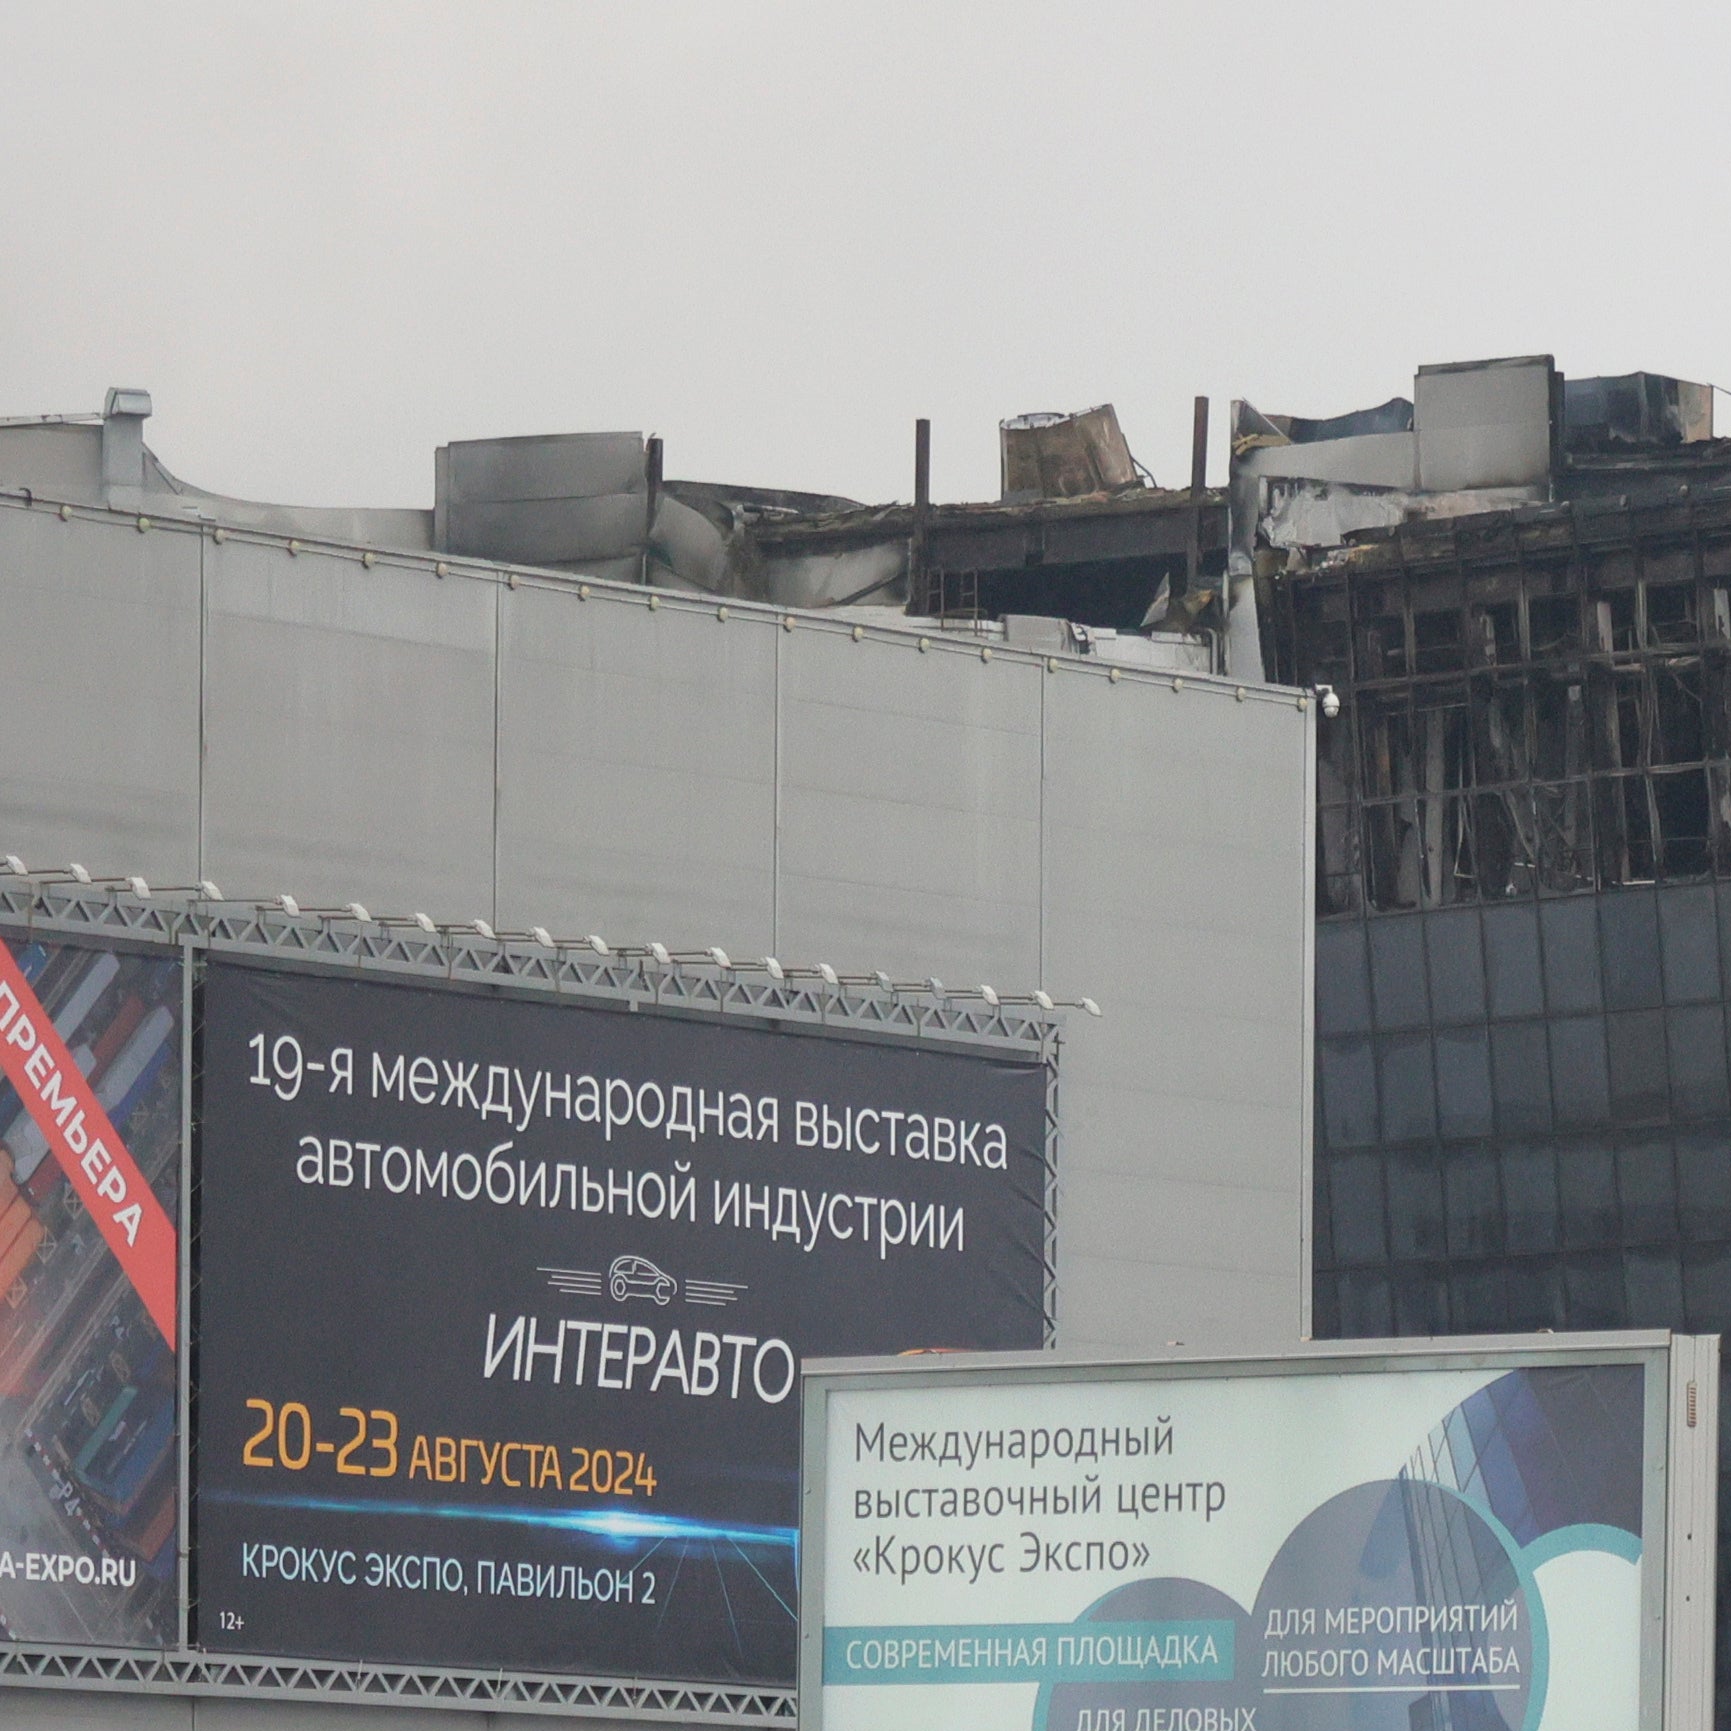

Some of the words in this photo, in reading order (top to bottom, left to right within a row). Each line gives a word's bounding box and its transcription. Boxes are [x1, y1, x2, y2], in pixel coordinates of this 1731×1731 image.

[0, 980, 142, 1247] ПРЕМЬЕРА
[248, 1032, 354, 1101] 19-я
[371, 1061, 780, 1143] международная
[795, 1098, 1008, 1170] выставка
[296, 1139, 696, 1224] автомобильной
[714, 1182, 965, 1260] индустрии
[484, 1314, 795, 1403] ИНТЕРАВТО
[243, 1399, 398, 1477] 20-23
[409, 1434, 562, 1490] АВГУСТА
[570, 1448, 656, 1497] 2024
[856, 1415, 1173, 1471] Международный
[855, 1475, 1100, 1519] выставочный
[1118, 1480, 1226, 1523] центр
[242, 1542, 357, 1586] КРОКУС
[364, 1551, 468, 1597] ЭКСПО,
[477, 1560, 634, 1604] ПАВИЛЬОН
[641, 1571, 656, 1605] 2
[853, 1535, 1004, 1585] «Крокус
[1019, 1531, 1150, 1573] Экспо»
[219, 1610, 245, 1631] 12+
[1263, 1608, 1316, 1640] ДЛЯ
[1325, 1597, 1518, 1635] МЕРОПРИЯТИЙ
[846, 1636, 1048, 1670] СОВРЕМЕННАЯ
[1056, 1635, 1219, 1671] ПЛОЩАДКА
[1261, 1649, 1369, 1678] ЛЮБОГО
[1377, 1646, 1521, 1677] МАСШТАБА
